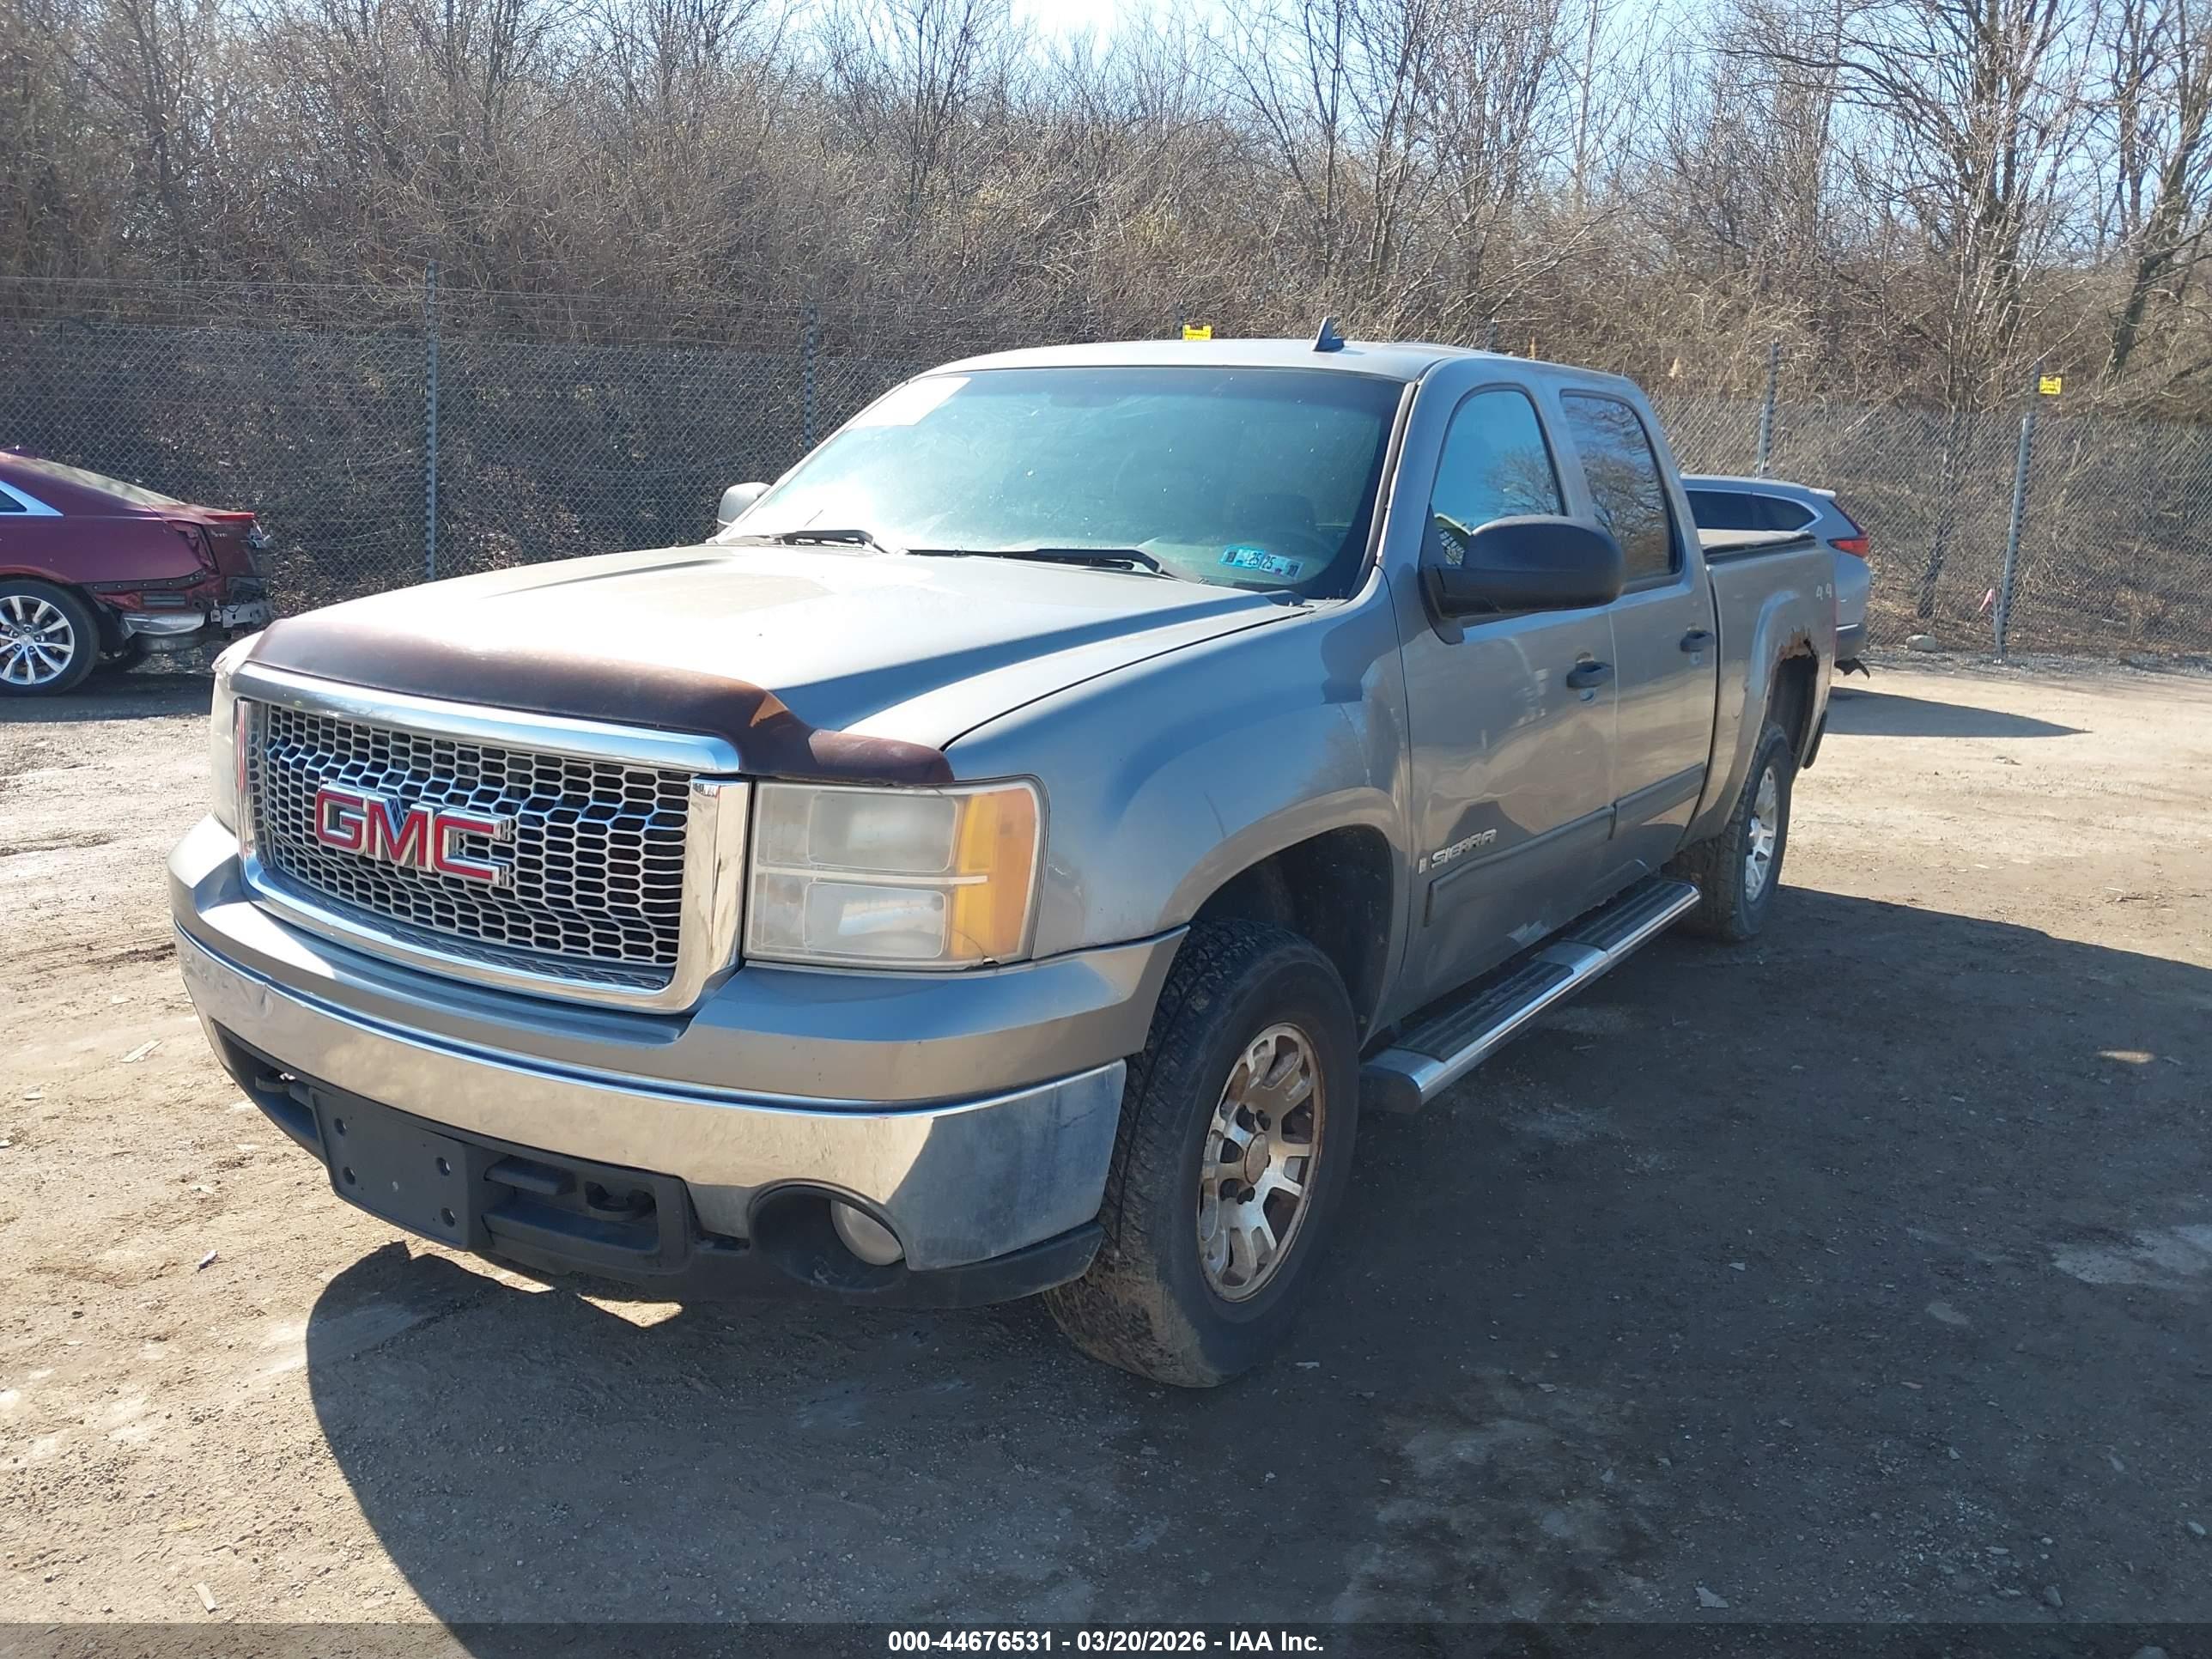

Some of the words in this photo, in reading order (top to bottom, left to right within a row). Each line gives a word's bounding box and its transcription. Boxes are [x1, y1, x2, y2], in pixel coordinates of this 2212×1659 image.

[1261, 555, 1277, 570] 25
[315, 785, 511, 886] GMC
[1431, 828, 1497, 869] SIERRA
